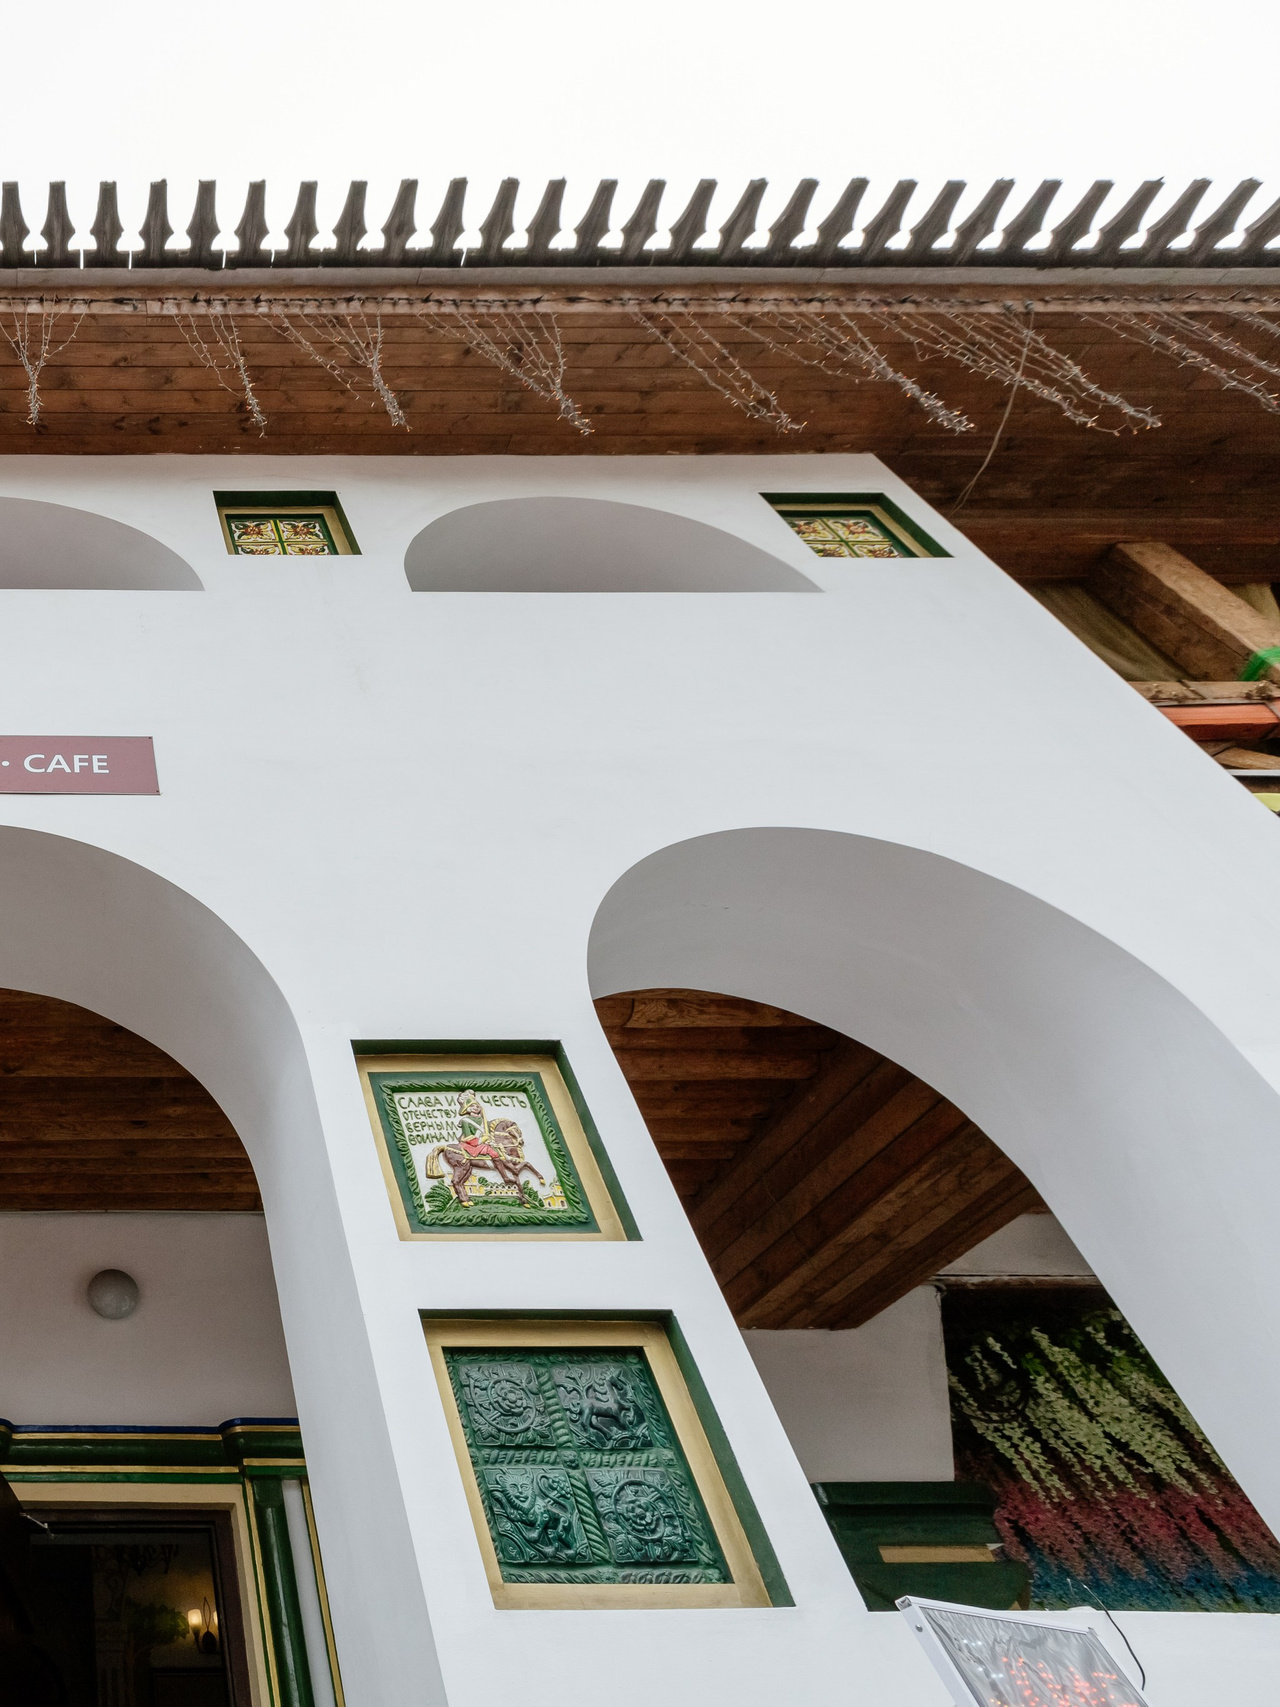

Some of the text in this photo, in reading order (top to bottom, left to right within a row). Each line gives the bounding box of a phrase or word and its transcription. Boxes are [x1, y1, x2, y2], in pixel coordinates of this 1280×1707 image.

[23, 754, 110, 773] CAFE
[398, 1095, 527, 1109] СЛАВА И ЧЕСТЬ
[402, 1108, 458, 1121] ОТЕЧЕСТВУ
[405, 1121, 459, 1133] ВЕРНЫМ
[408, 1132, 458, 1145] ВОИНАМ
